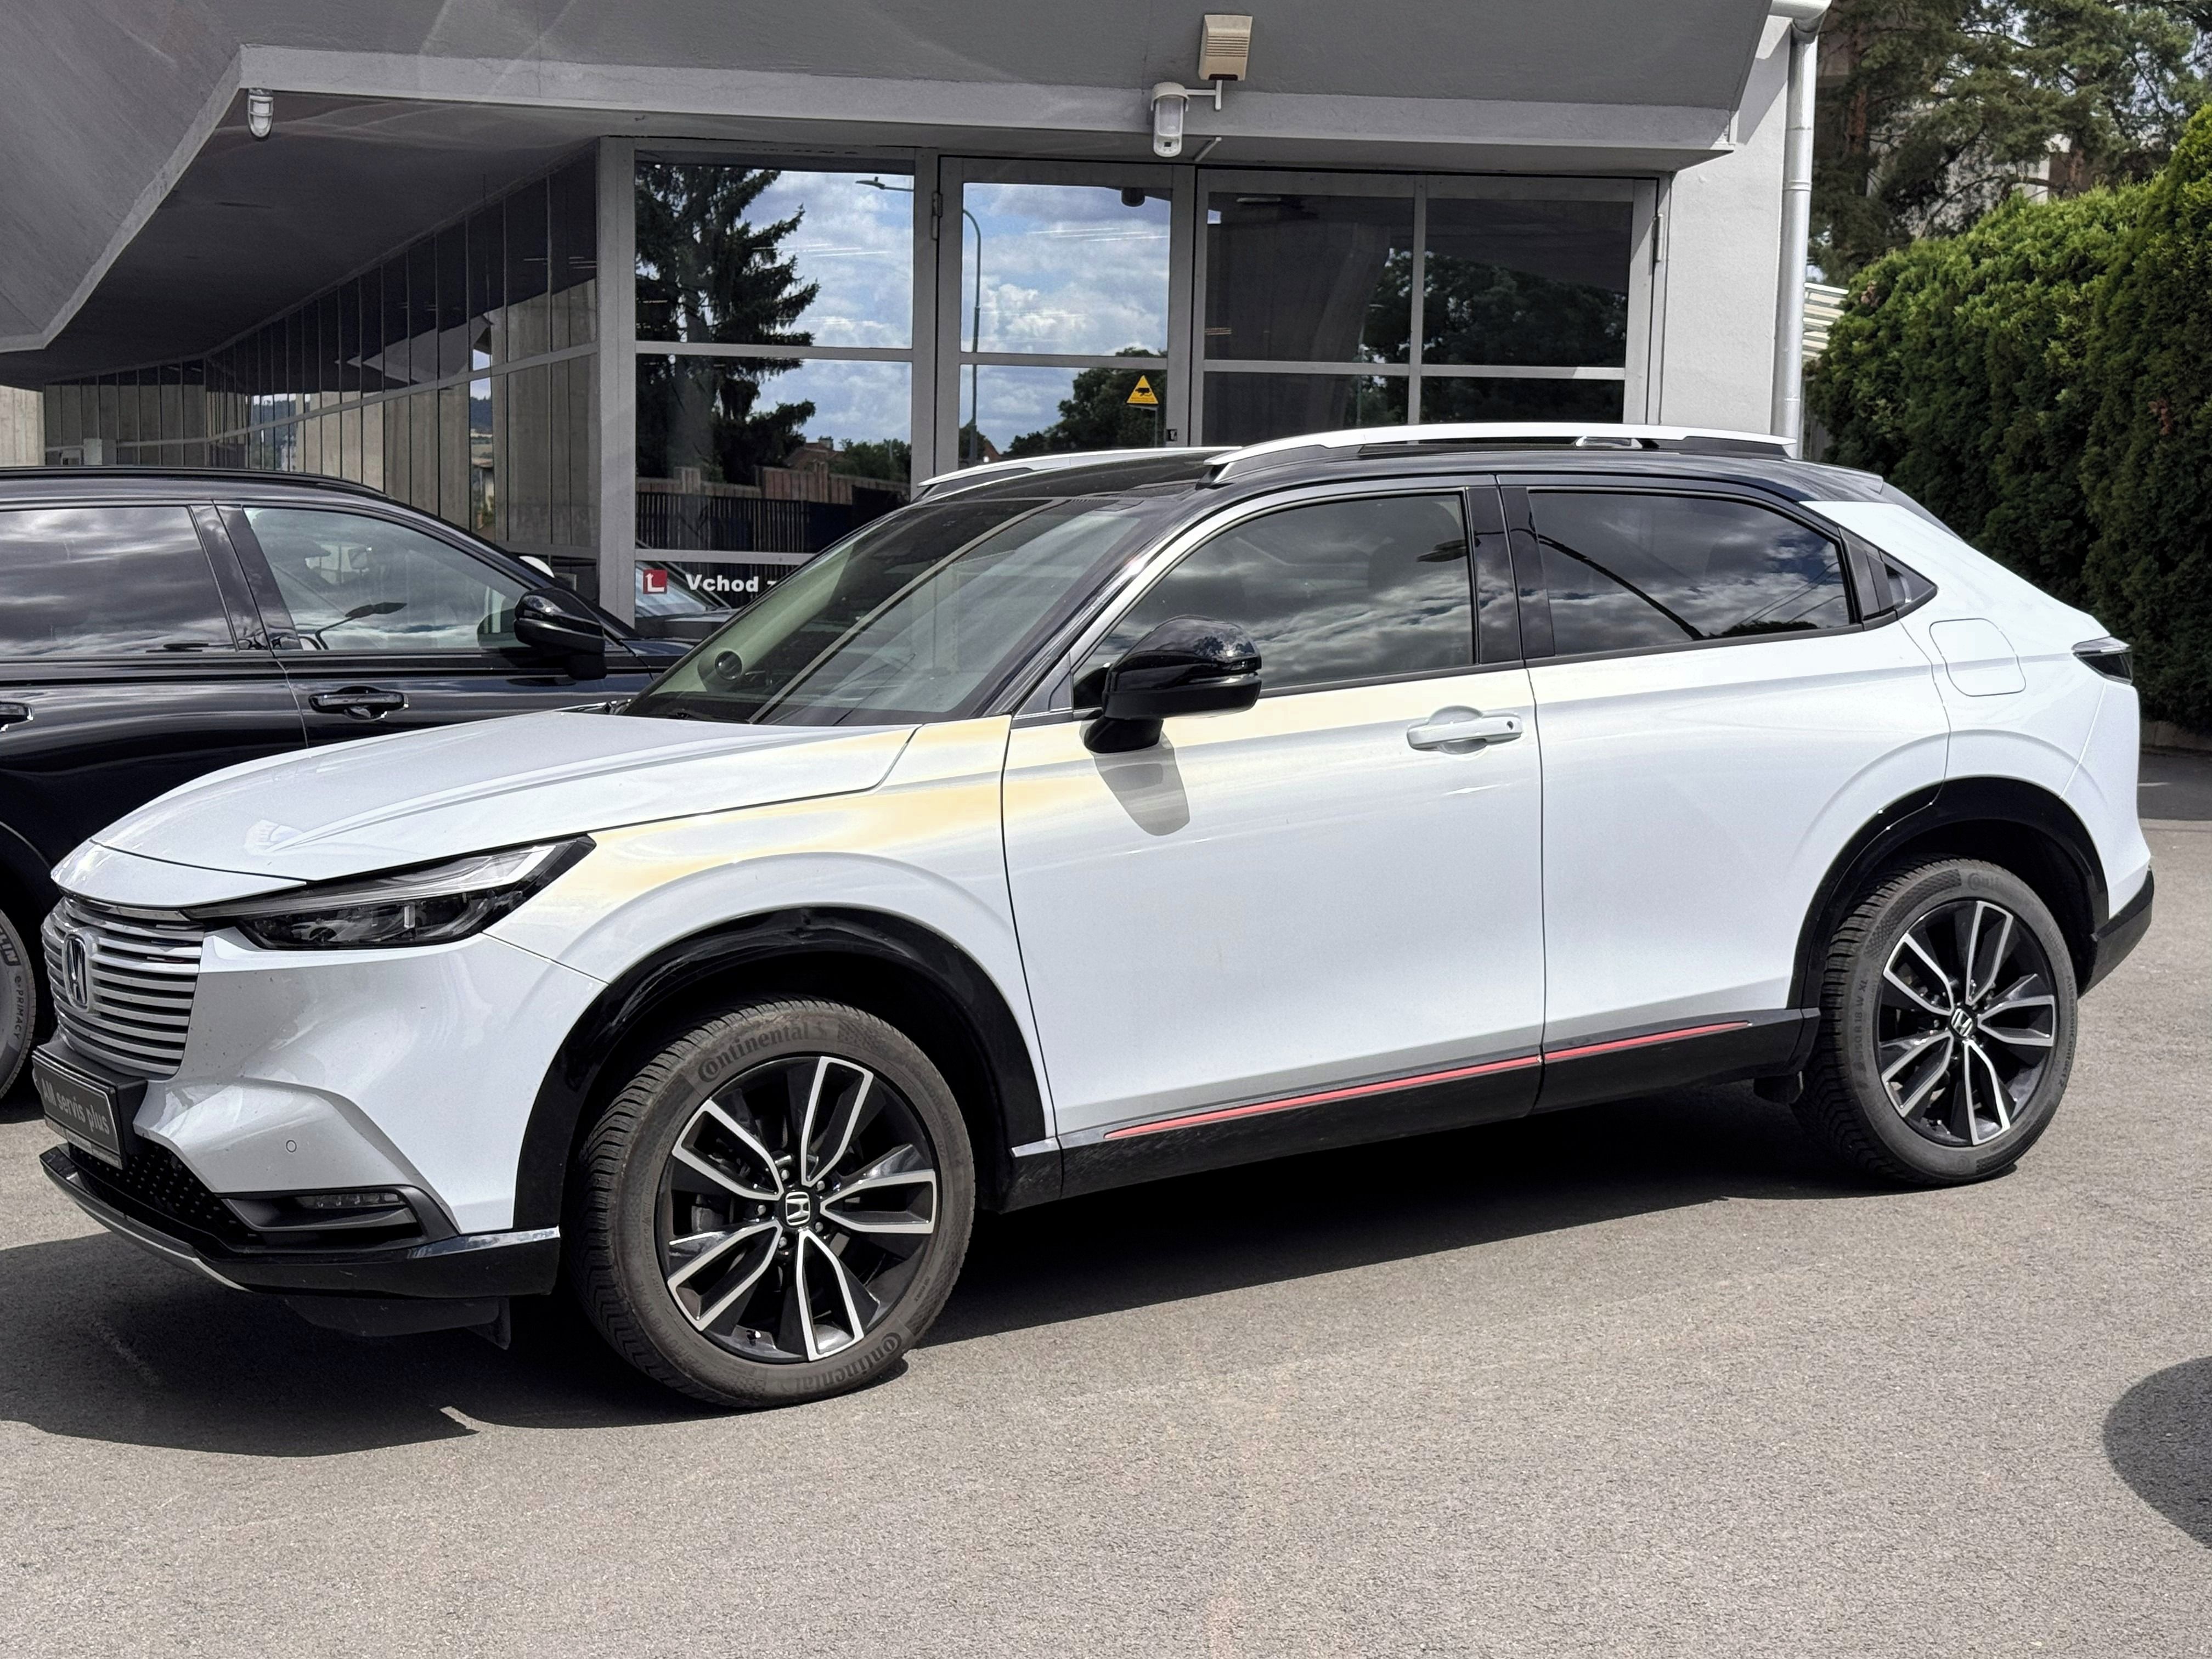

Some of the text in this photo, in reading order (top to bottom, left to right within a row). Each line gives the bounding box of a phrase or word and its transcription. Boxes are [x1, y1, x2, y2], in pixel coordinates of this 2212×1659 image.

[685, 574, 759, 592] Vchod
[1854, 1012, 1862, 1023] 18
[1858, 979, 1868, 991] XL
[698, 1022, 808, 1082] Continental
[56, 1092, 86, 1123] servis
[86, 1104, 110, 1135] plus
[796, 1332, 902, 1390] Continental
